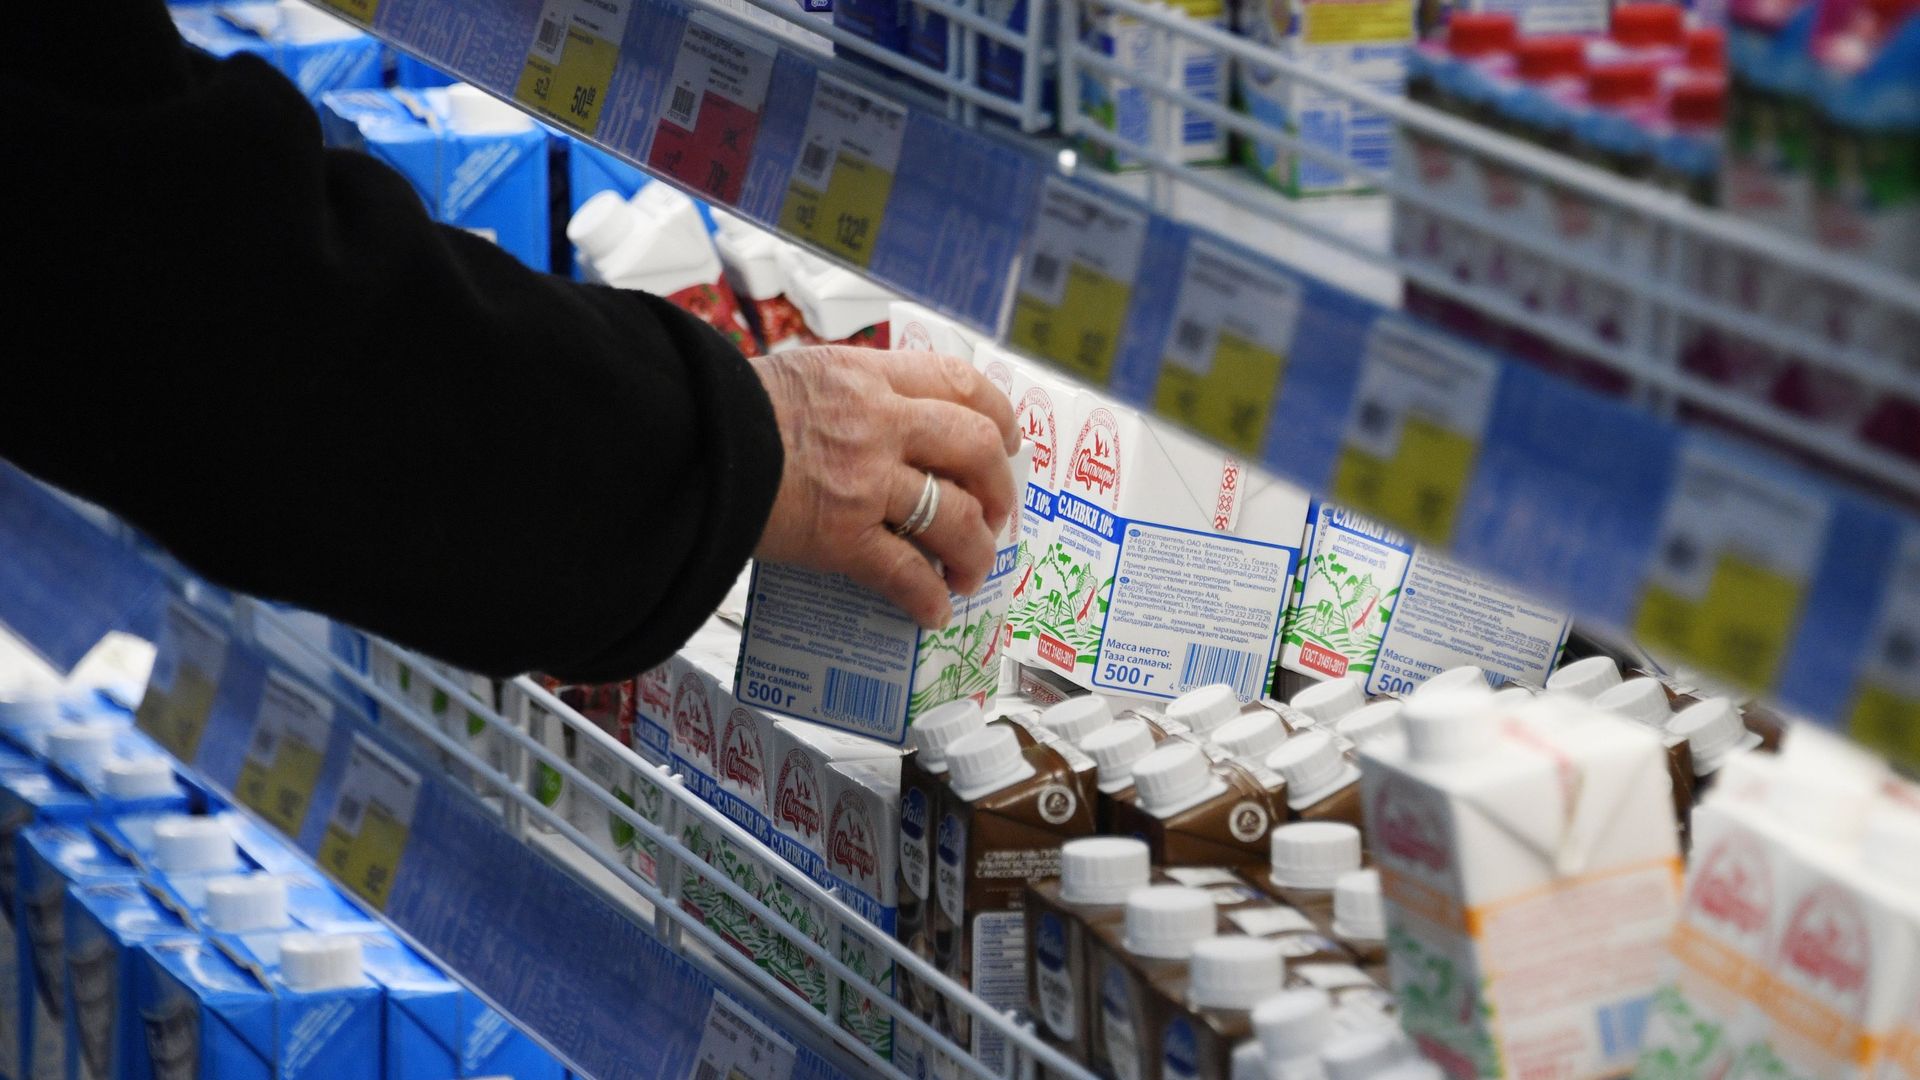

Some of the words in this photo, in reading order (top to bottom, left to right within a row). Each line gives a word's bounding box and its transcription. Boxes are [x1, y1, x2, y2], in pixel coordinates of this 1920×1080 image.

[1034, 491, 1052, 516] 10%
[1057, 493, 1098, 528] СЛИВКИ
[1097, 512, 1115, 538] 10%
[1159, 542, 1201, 556] Республика
[1186, 538, 1201, 546] ОАО
[992, 548, 1016, 577] 10%
[1121, 568, 1142, 576] союза
[1192, 573, 1230, 585] территории
[1232, 579, 1276, 593] Таможенного
[1039, 638, 1052, 656] ГОСТ
[1106, 638, 1136, 651] Масса
[1138, 645, 1169, 657] нетто:
[1301, 646, 1318, 663] ГОСТ
[1383, 648, 1414, 666] Масса
[748, 655, 777, 673] Масса
[778, 662, 810, 681] нетто:
[1103, 650, 1124, 661] Таза
[1126, 655, 1172, 670] салмағы:
[1380, 660, 1401, 676] Таза
[745, 667, 765, 683] Таза
[1104, 661, 1140, 685] 500
[1143, 673, 1153, 687] г
[1378, 673, 1415, 693] 500
[747, 681, 782, 706] 500
[785, 693, 797, 708] г
[717, 791, 754, 832] СЛИВКИ
[755, 816, 769, 843] 10%
[770, 834, 810, 873] СЛИВКИ
